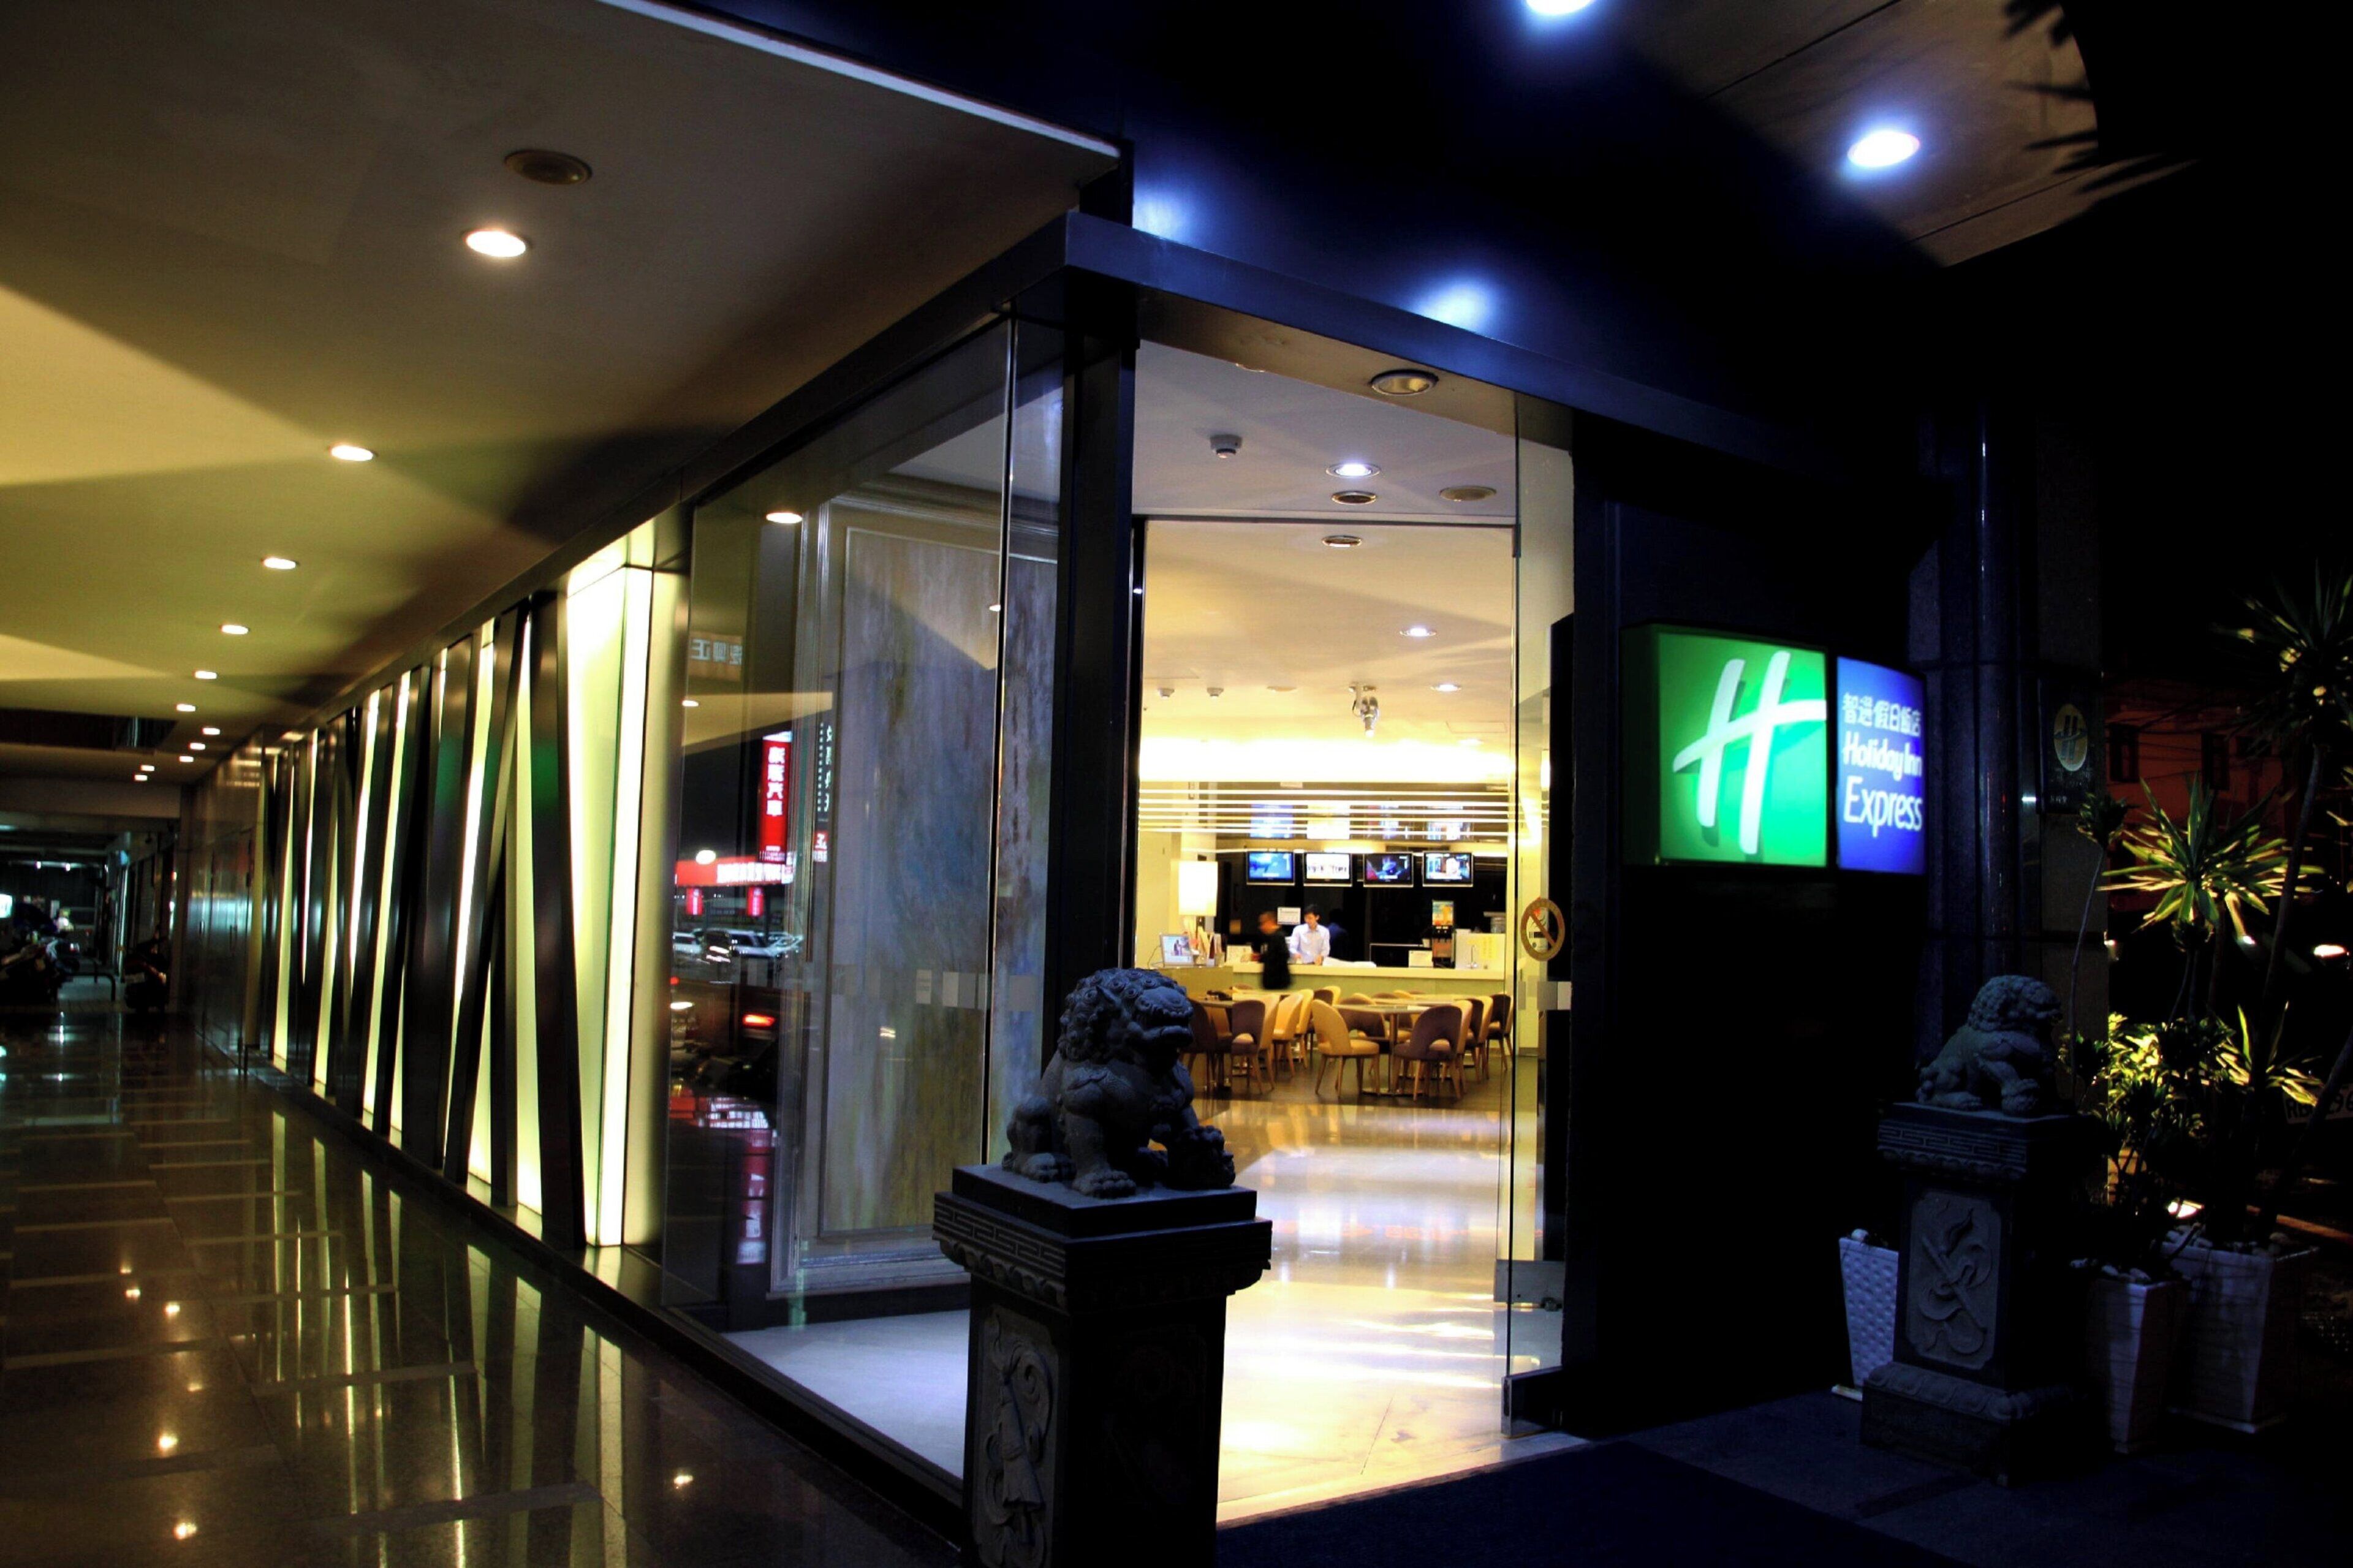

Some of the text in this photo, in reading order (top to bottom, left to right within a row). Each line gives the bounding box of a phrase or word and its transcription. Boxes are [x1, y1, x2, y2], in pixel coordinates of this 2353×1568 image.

[1843, 730, 1922, 781] Holiday Inn
[1843, 775, 1923, 838] Express
